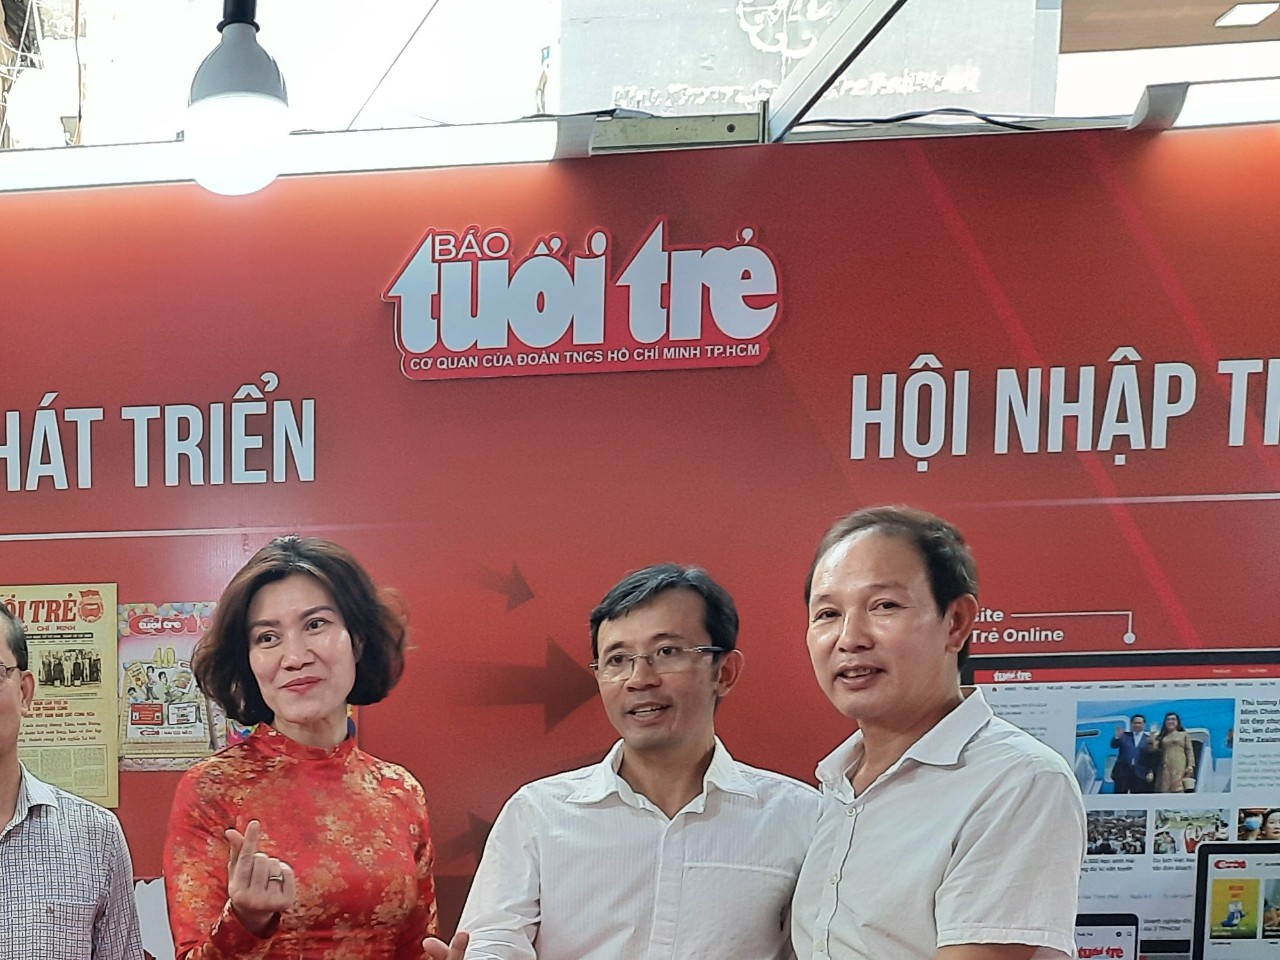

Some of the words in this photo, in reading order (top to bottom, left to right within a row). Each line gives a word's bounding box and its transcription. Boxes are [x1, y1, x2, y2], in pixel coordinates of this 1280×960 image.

[434, 228, 511, 260] BÁO
[387, 231, 608, 354] tuổi
[615, 220, 779, 345] trẻ
[410, 354, 433, 371] CƠ
[436, 353, 479, 370] QUAN
[482, 349, 514, 368] CỦA
[517, 347, 560, 367] ĐOÀN
[564, 350, 604, 365] TNCS
[607, 344, 630, 363] HỒ
[633, 343, 660, 362] CHÍ
[663, 346, 701, 361] MINH
[704, 343, 761, 359] TP.HCM
[850, 353, 970, 472] HỘI
[993, 346, 1198, 466] NHẬP
[120, 371, 317, 487] TRIỂN
[29, 592, 78, 623] TRẺ
[971, 626, 1000, 643] Trẻ
[1003, 626, 1065, 642] Online
